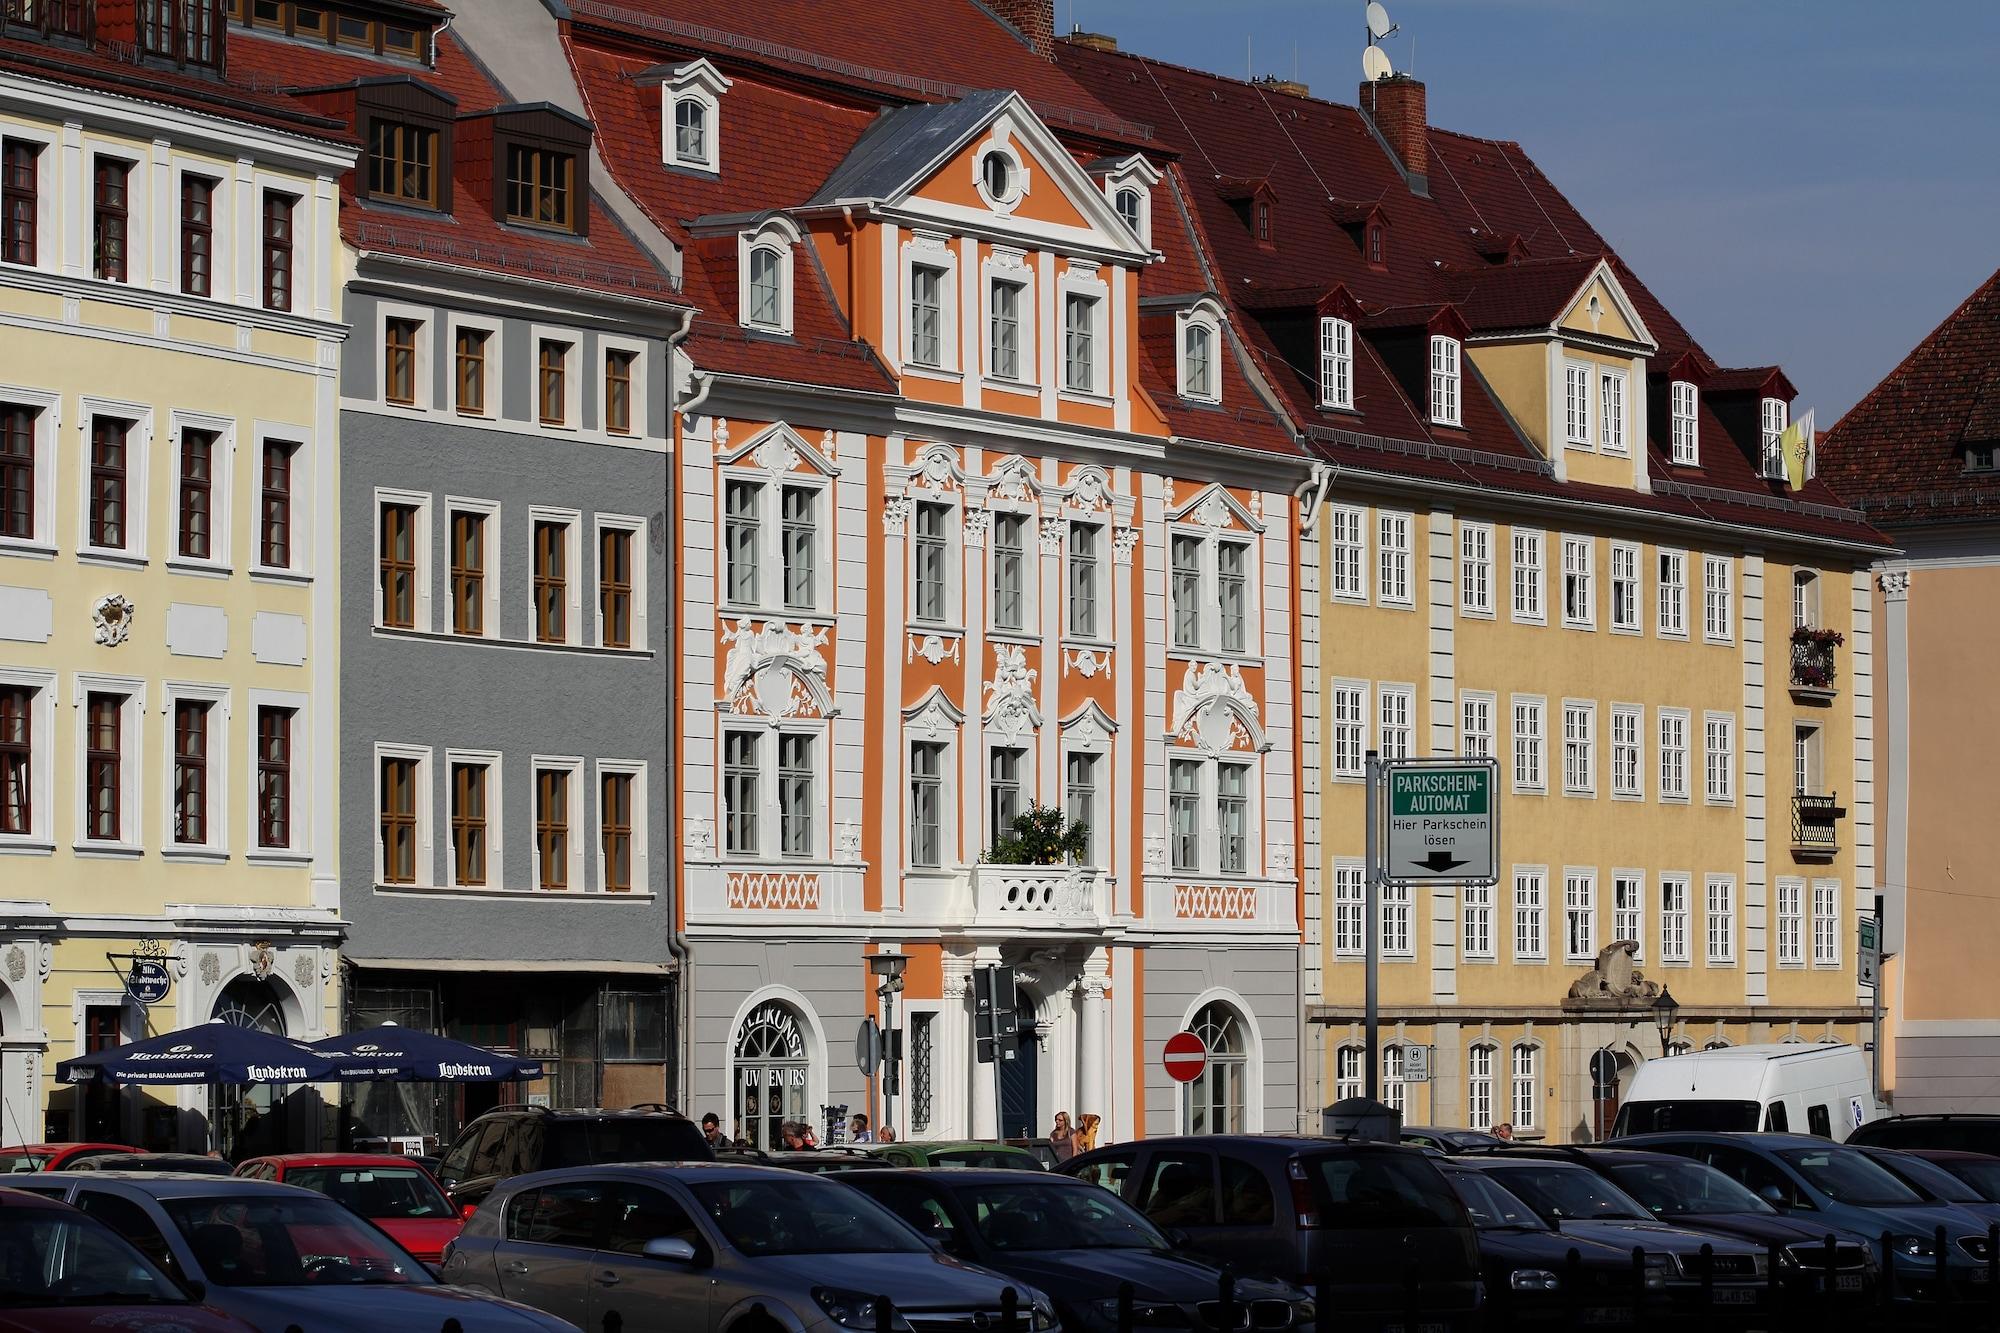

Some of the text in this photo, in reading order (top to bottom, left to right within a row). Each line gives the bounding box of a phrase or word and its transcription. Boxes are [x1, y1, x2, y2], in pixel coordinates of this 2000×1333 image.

[1397, 775, 1483, 793] PARKSCHEIN-
[1410, 794, 1470, 812] AUTOMAT
[1393, 818, 1487, 830] Hier Parkschein
[1424, 834, 1455, 845] lösen
[148, 1071, 205, 1079] BRAU-MANUFAKTUR
[247, 1064, 307, 1082] Landskron
[438, 1062, 493, 1079] Landskron
